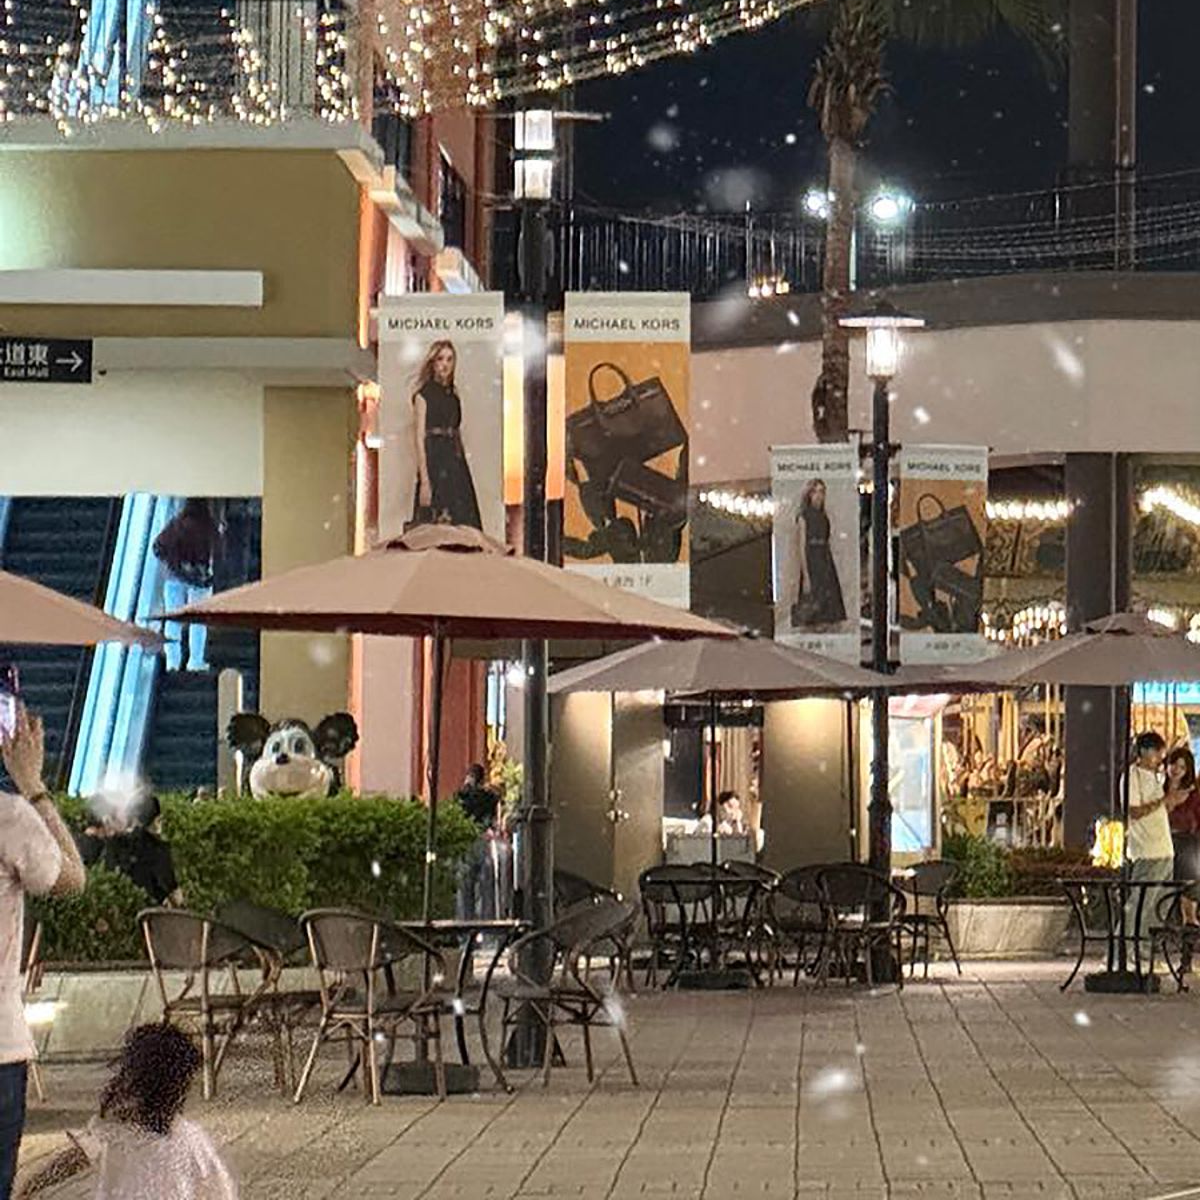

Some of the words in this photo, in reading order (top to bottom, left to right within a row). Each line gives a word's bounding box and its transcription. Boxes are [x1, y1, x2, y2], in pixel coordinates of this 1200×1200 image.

[387, 317, 450, 330] MICHAEL
[455, 317, 494, 330] KORS
[573, 317, 636, 331] MICHAEL
[641, 318, 681, 331] KORS
